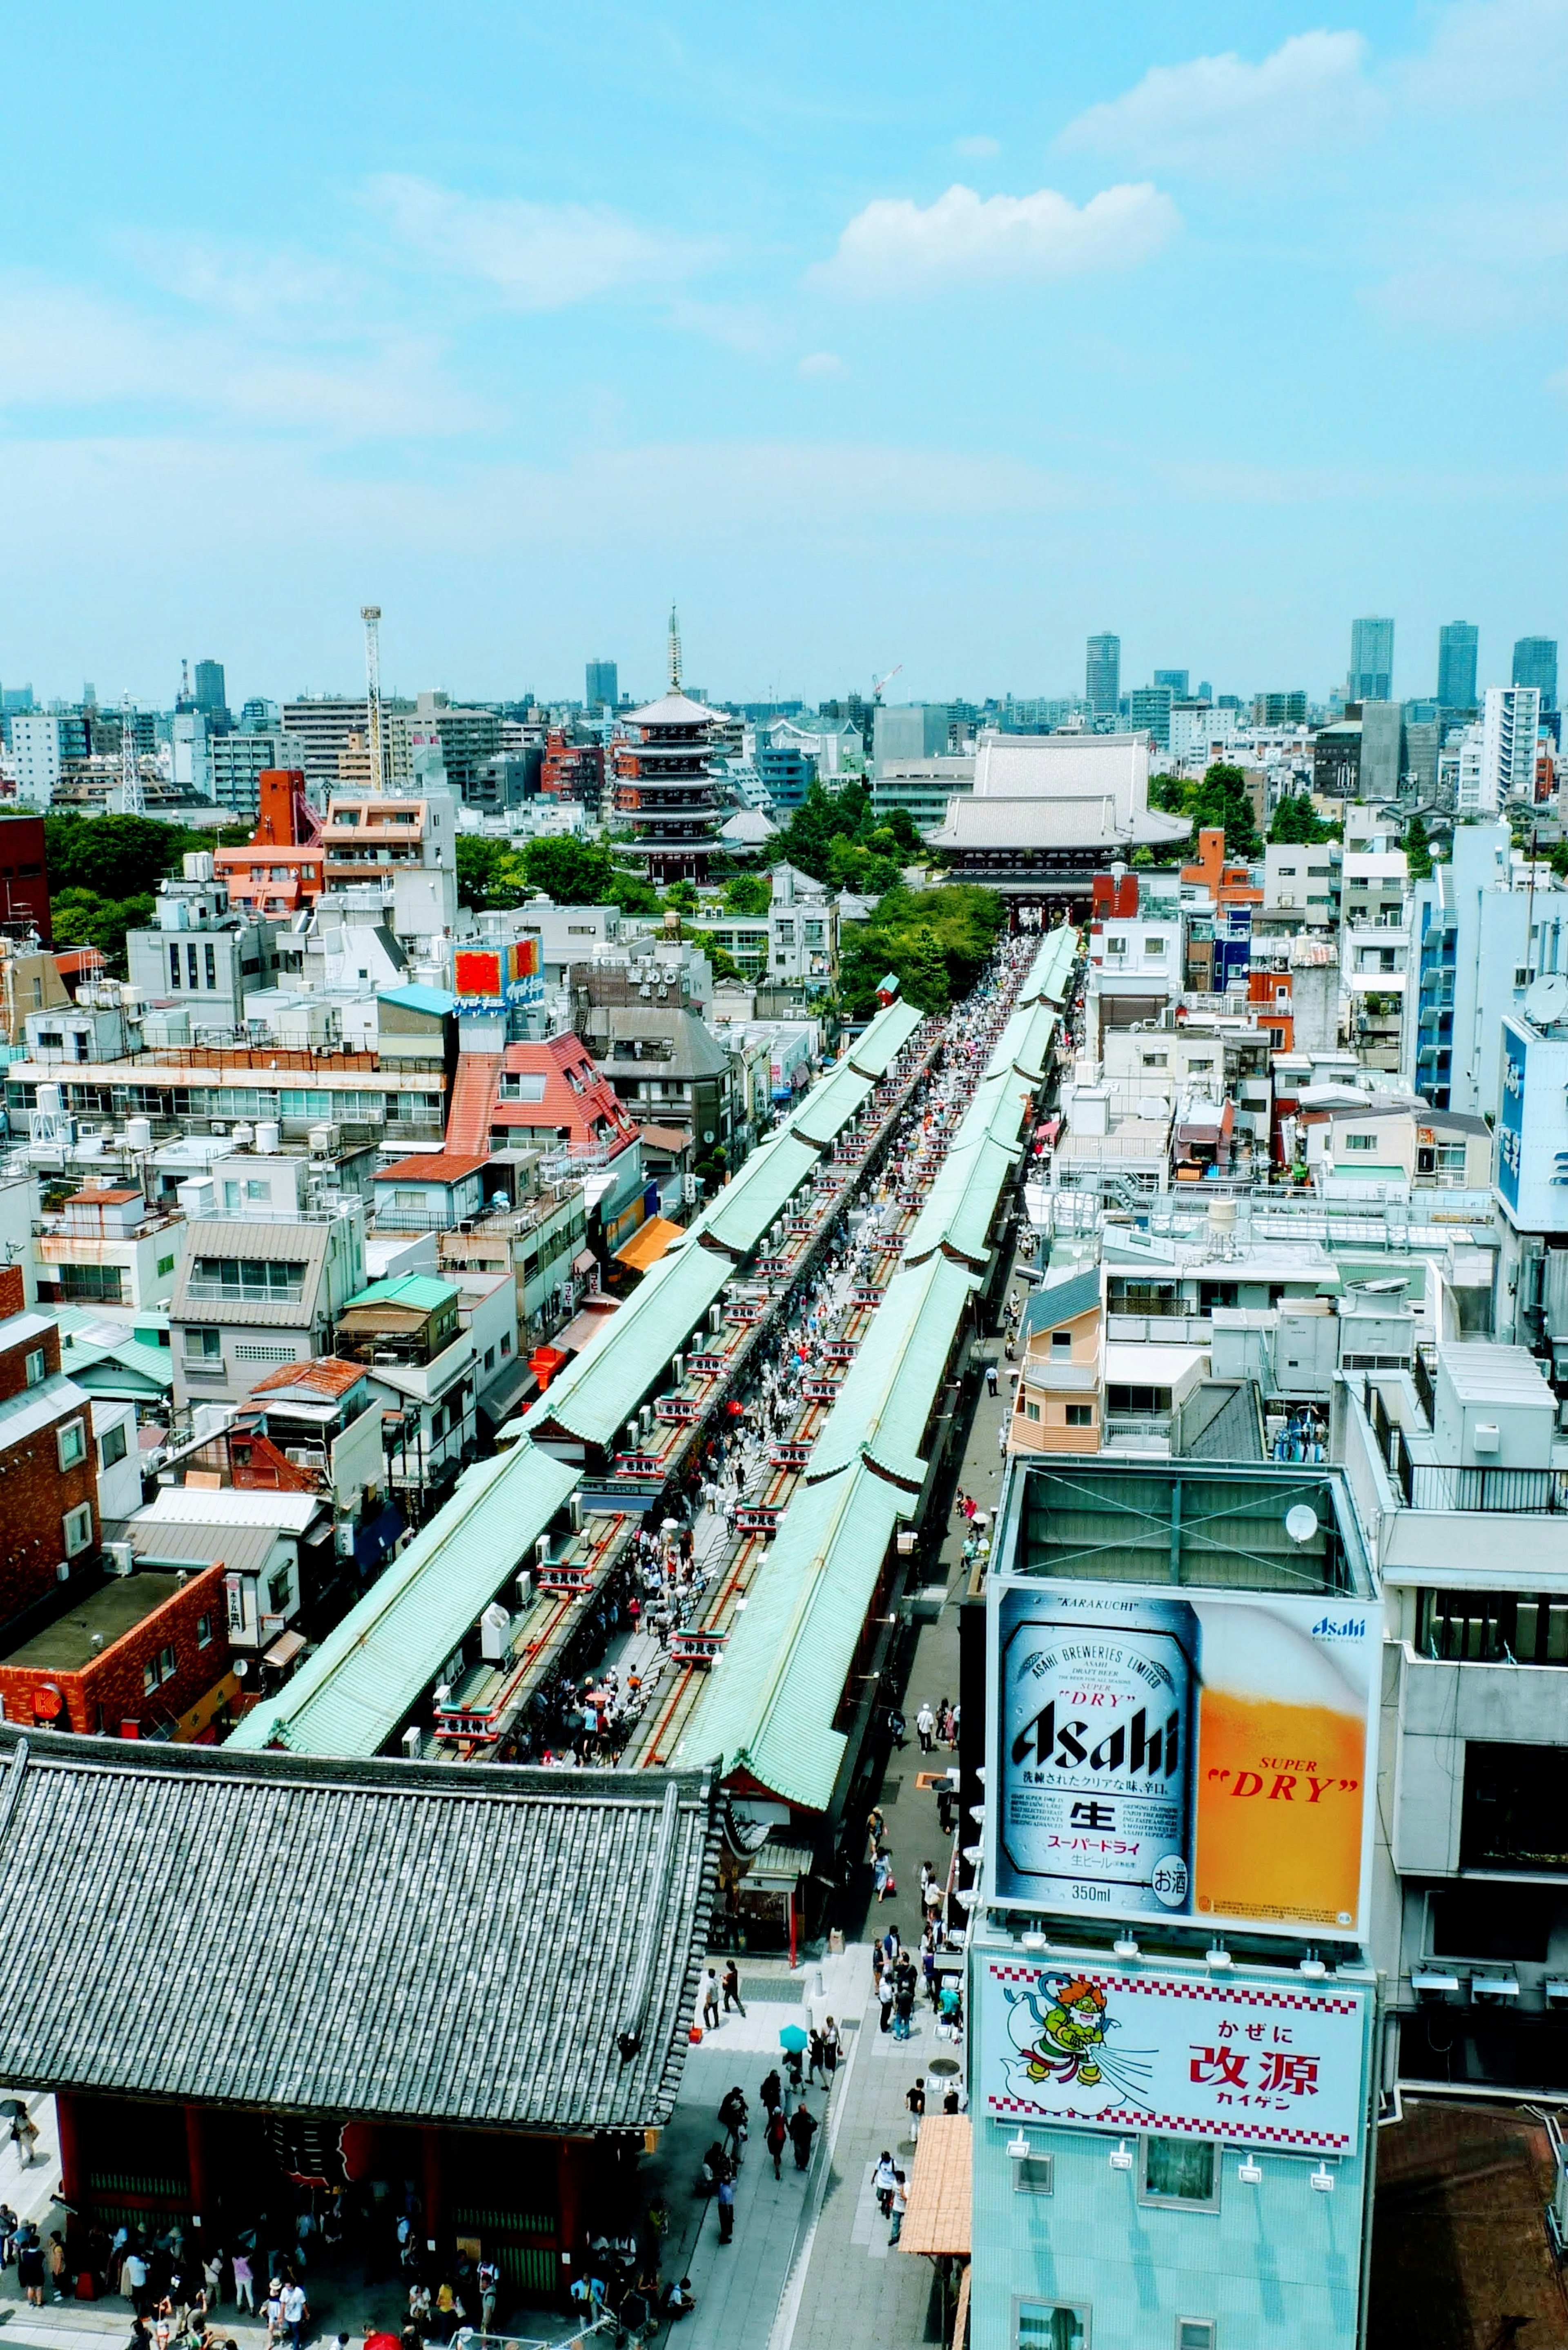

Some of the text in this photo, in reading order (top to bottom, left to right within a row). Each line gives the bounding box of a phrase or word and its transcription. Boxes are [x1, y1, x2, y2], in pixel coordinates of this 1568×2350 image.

[1312, 1616, 1365, 1637] Asahi
[1032, 1646, 1161, 1689] ASAHI BREWERIES LIMITED
[1080, 1683, 1111, 1691] SUPER
[1011, 1700, 1179, 1779] Asahi
[1259, 1757, 1317, 1773] SUPER
[1023, 1771, 1168, 1795] 洗練されたクリアな味、辛口。
[1070, 1801, 1116, 1832] 生
[1048, 1835, 1140, 1855] スーパードライ
[1071, 1854, 1112, 1869] 生ビール
[1072, 1885, 1111, 1902] 350ml
[1155, 1870, 1186, 1895] お酒
[1218, 2020, 1294, 2043] かぜに
[1189, 2045, 1321, 2096] 改源
[1216, 2091, 1290, 2111] カイゲン
